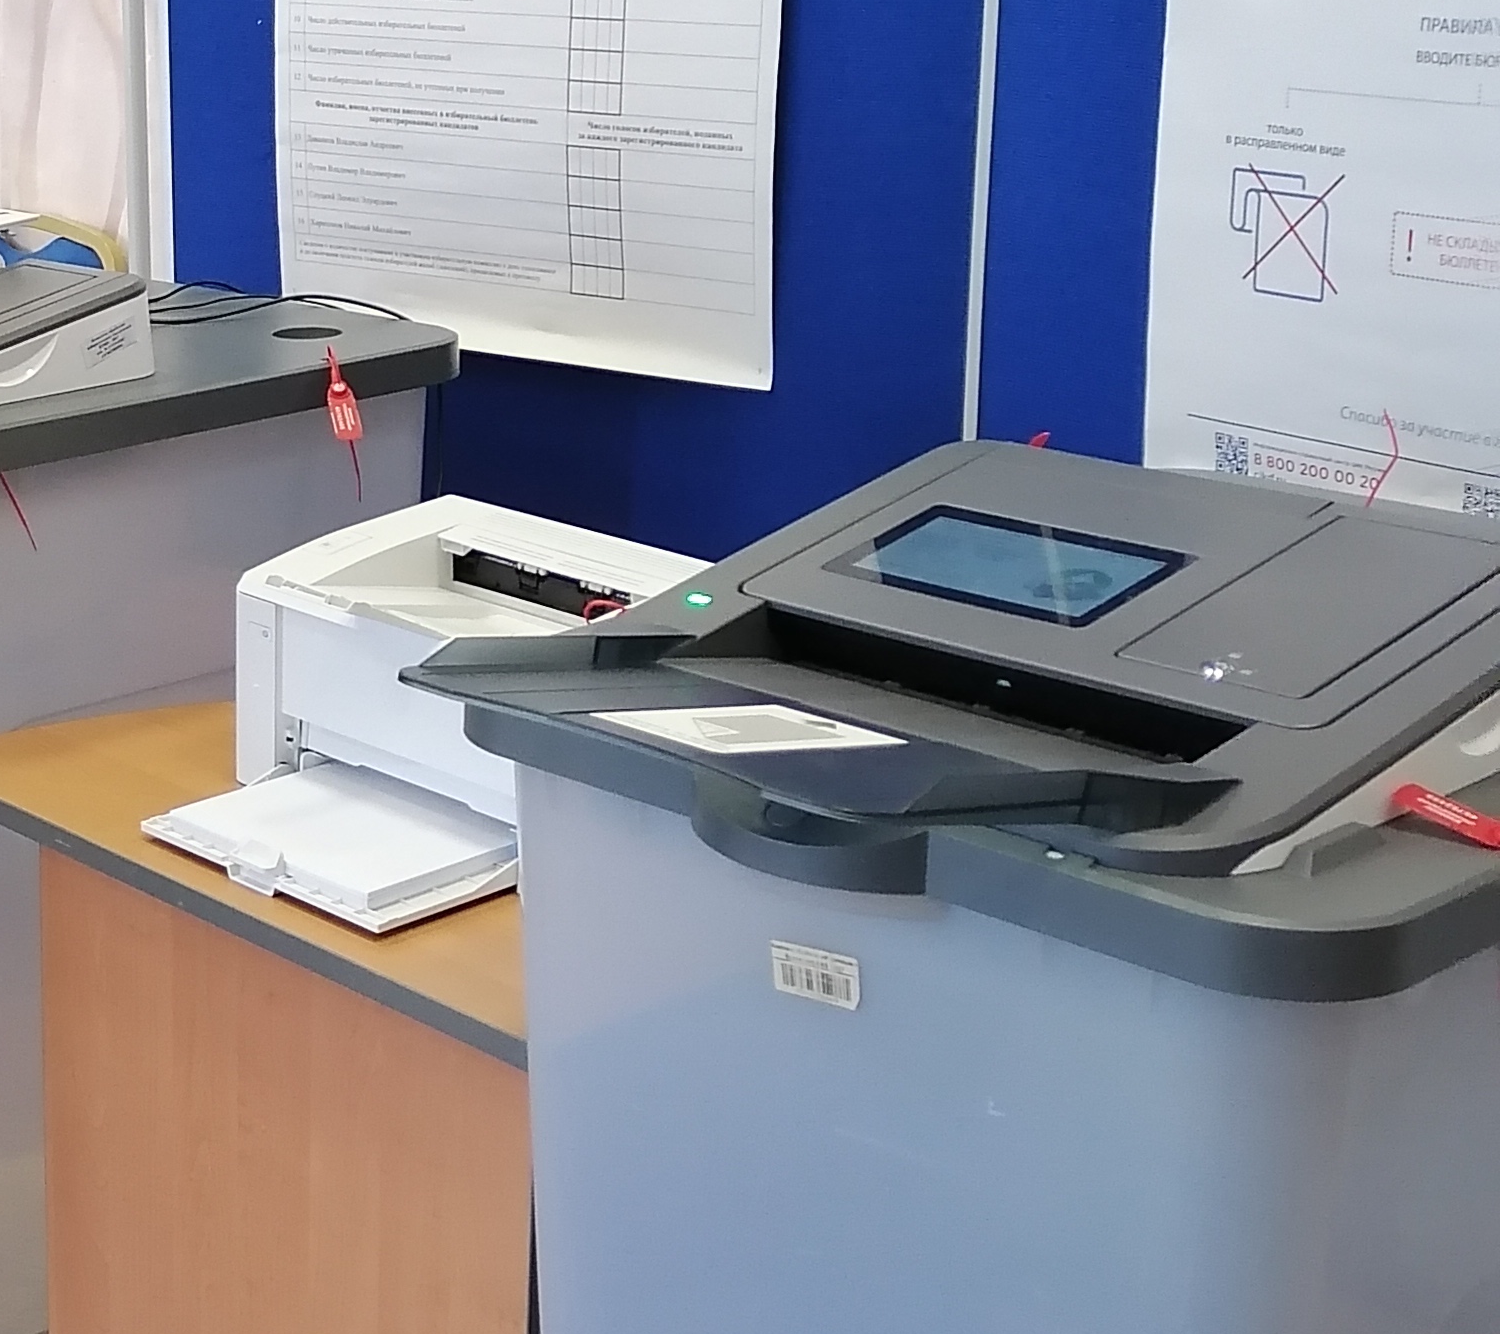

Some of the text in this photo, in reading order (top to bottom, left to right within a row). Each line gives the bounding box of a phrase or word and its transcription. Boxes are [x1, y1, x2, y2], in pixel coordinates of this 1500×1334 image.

[1419, 16, 1493, 35] ПРАВИЛА
[1416, 49, 1472, 67] ВВОДИТЕ
[1266, 123, 1304, 138] только
[1225, 134, 1347, 158] в расправленном виде
[1399, 419, 1416, 433] за
[1253, 452, 1263, 466] 8
[1266, 455, 1295, 473] 800
[1300, 462, 1329, 480] 200
[1334, 469, 1355, 486] 00
[1359, 475, 1379, 490] 20
